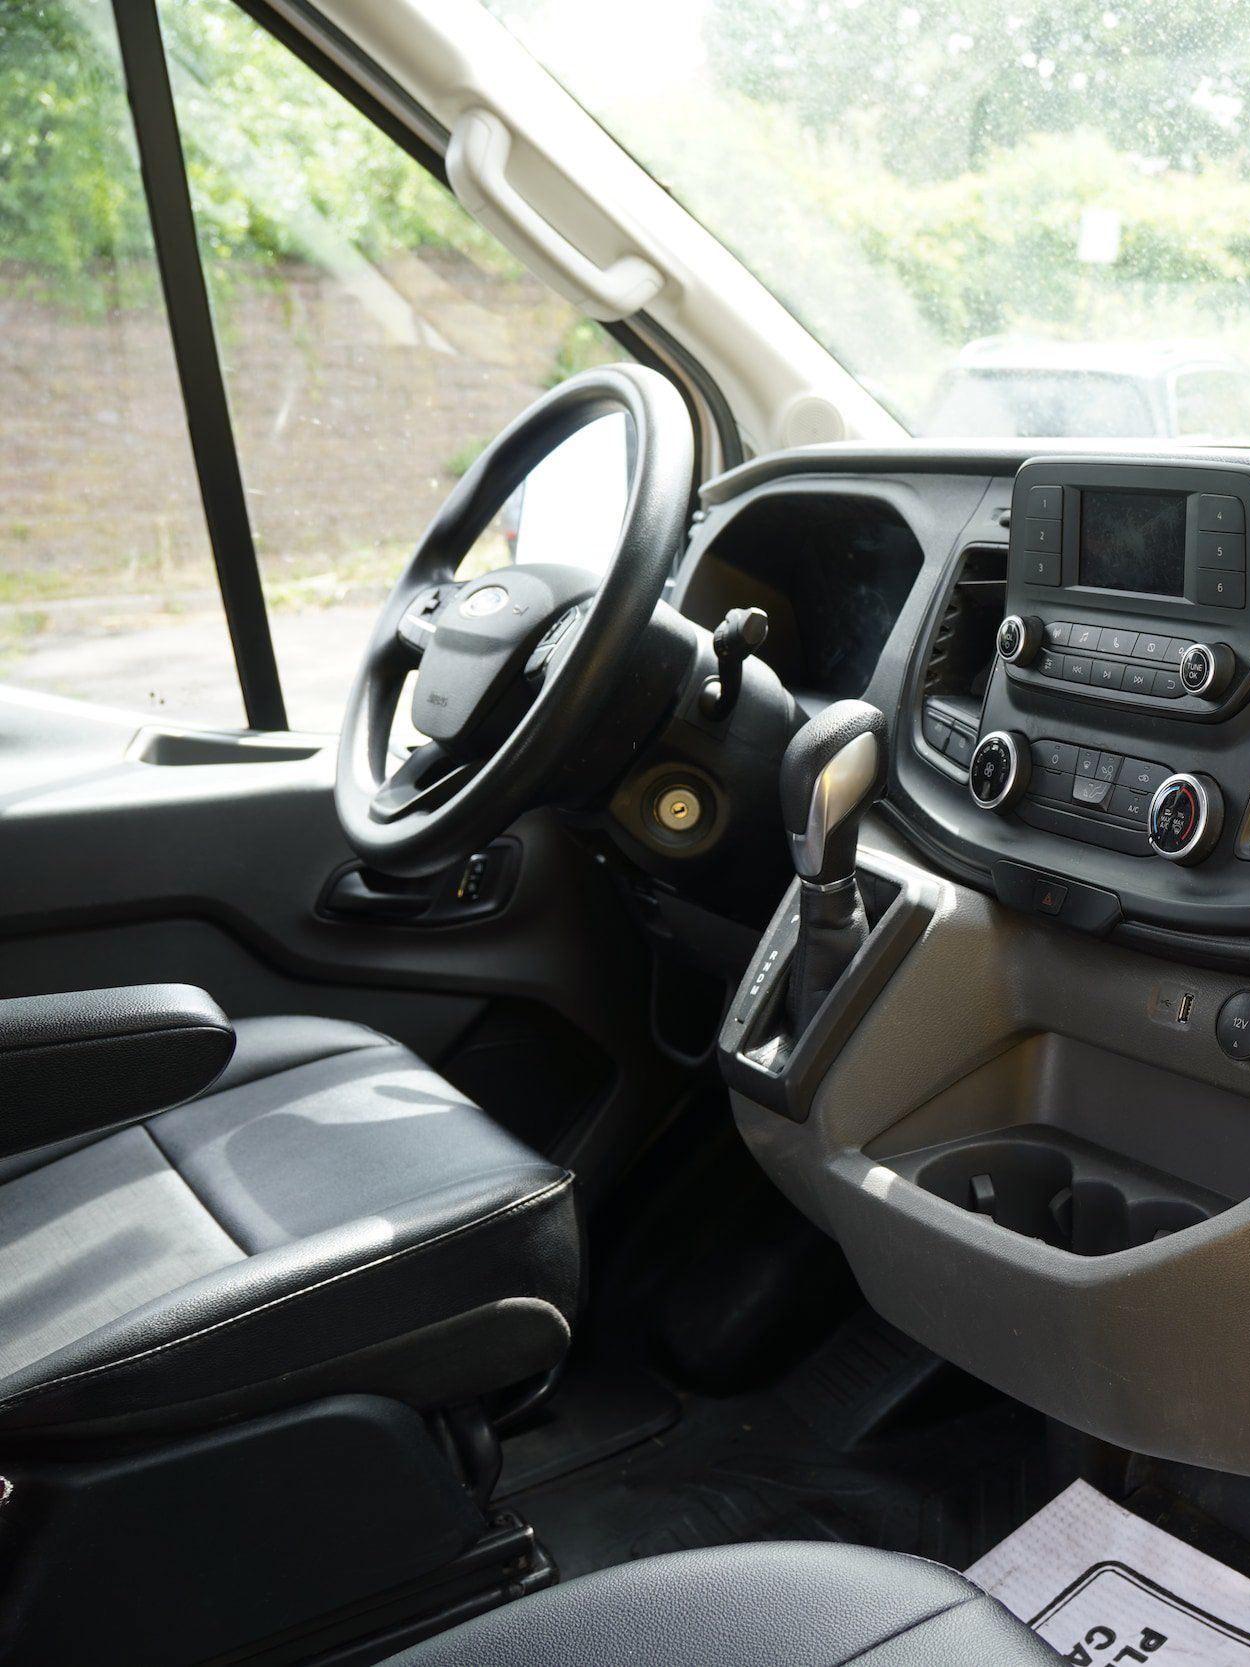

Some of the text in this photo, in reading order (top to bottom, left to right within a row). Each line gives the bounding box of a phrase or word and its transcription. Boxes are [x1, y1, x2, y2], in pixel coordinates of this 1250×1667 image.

[1216, 512, 1222, 520] 4
[1039, 531, 1045, 540] 2
[1217, 546, 1223, 557] 5
[1038, 563, 1044, 573] 3
[1217, 583, 1223, 593] 6
[1187, 662, 1204, 672] TUNE
[1188, 671, 1198, 679] OK
[1128, 805, 1139, 813] A/C
[1173, 818, 1184, 826] MAX
[790, 914, 800, 924] P
[769, 950, 778, 960] R
[762, 961, 772, 972] N
[756, 973, 765, 983] D
[1233, 1017, 1249, 1029] 12V
[1104, 1626, 1168, 1667] PL
